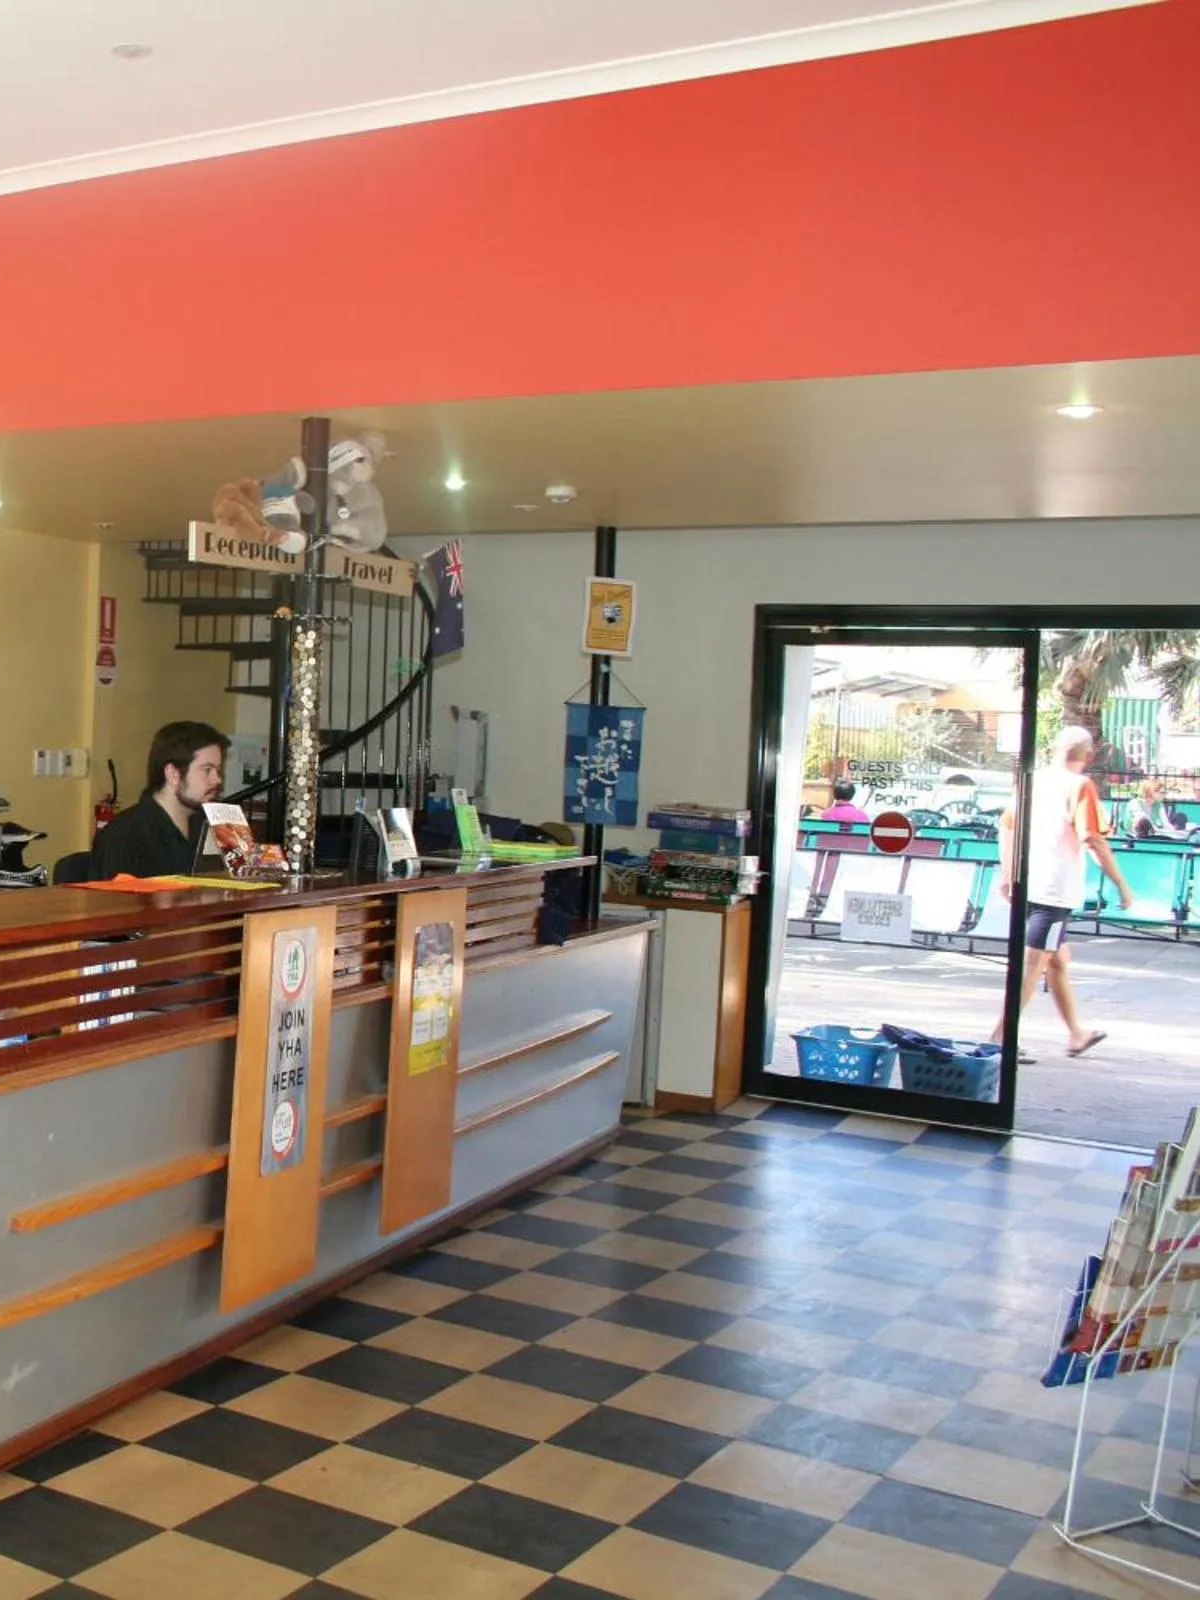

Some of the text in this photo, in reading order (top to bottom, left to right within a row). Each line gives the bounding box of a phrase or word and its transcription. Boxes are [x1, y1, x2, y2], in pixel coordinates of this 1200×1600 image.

[342, 555, 394, 585] Travel
[847, 759, 942, 776] GUESTS ONLY
[861, 776, 934, 792] PAST THIS
[874, 793, 919, 807] POINT
[278, 1007, 305, 1033] JOIN
[278, 1037, 302, 1059] YHA
[272, 1066, 305, 1094] HERE
